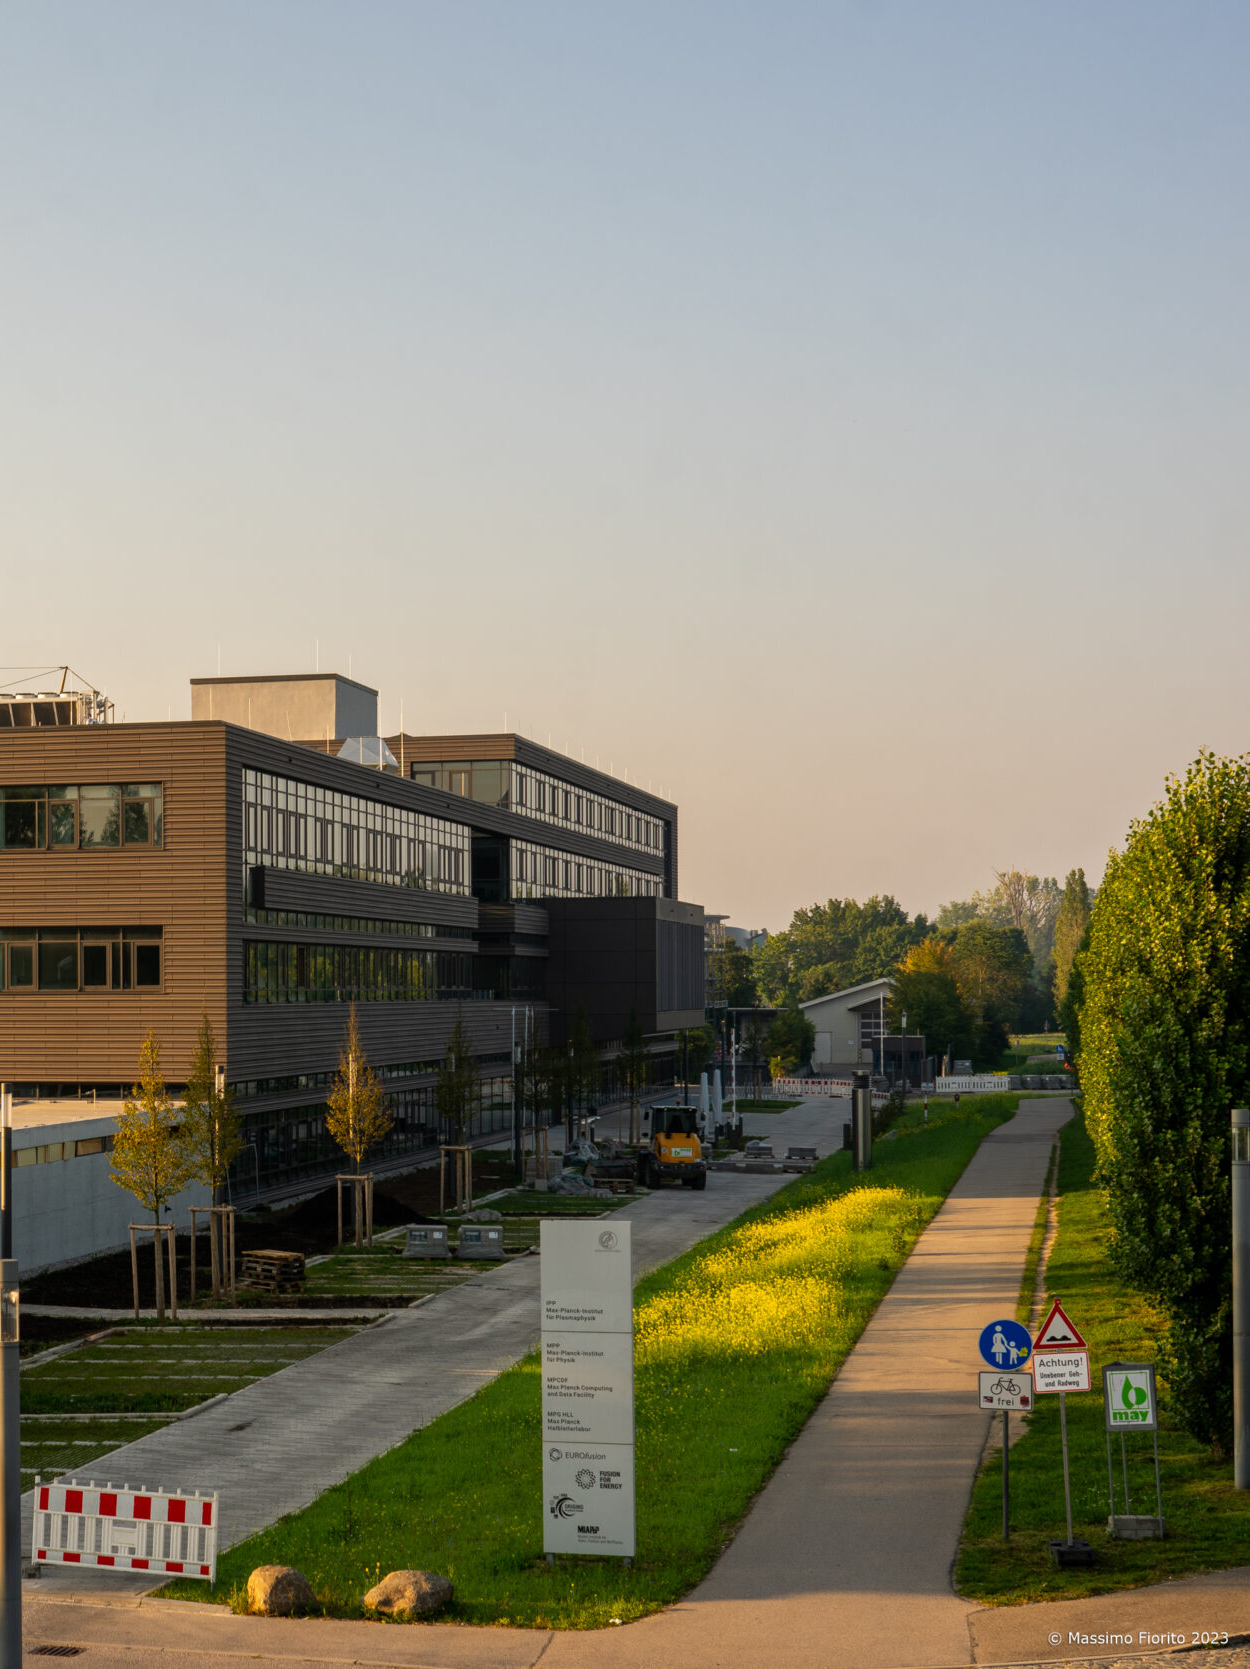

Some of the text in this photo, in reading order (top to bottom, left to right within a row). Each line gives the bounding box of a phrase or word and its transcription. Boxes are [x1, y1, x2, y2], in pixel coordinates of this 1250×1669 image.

[556, 1314, 596, 1322] Plasmaphysik
[1039, 1357, 1083, 1368] Achtung!
[998, 1398, 1014, 1406] frei
[1112, 1410, 1150, 1422] may
[565, 1451, 606, 1460] EUROfusion
